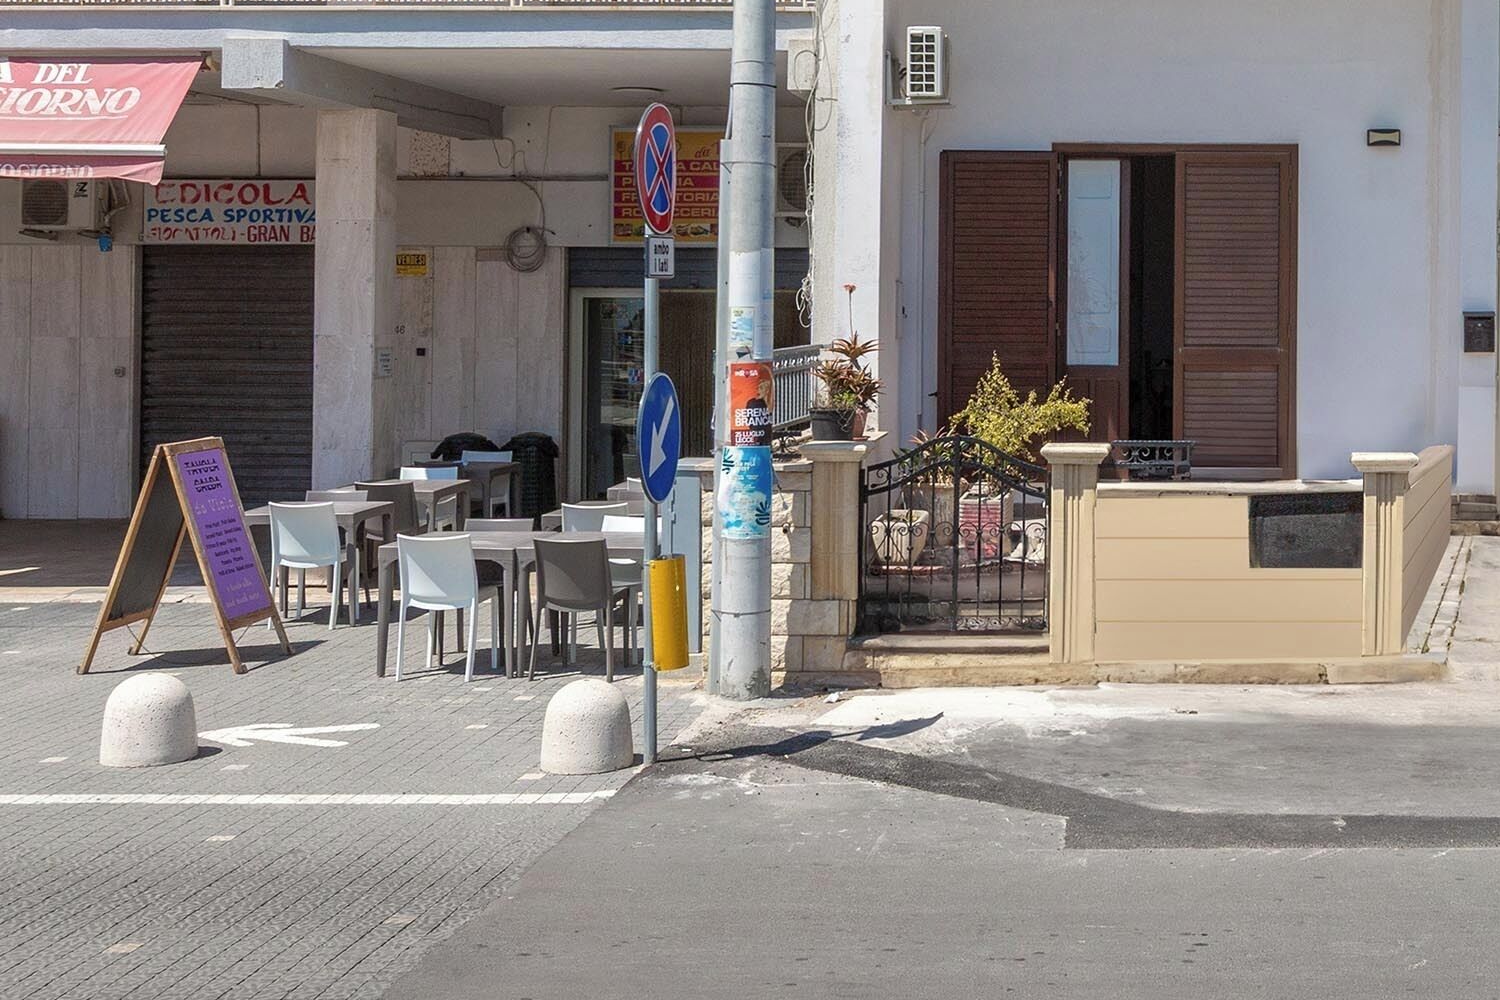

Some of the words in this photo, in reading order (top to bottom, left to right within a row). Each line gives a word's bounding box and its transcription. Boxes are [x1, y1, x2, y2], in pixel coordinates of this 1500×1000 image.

[32, 64, 93, 84] DEL
[0, 88, 141, 115] IORNO
[155, 183, 312, 205] EDICOLA
[147, 208, 214, 223] PESCA
[223, 208, 315, 223] SPORTIVA
[183, 458, 220, 476] TAVOLA
